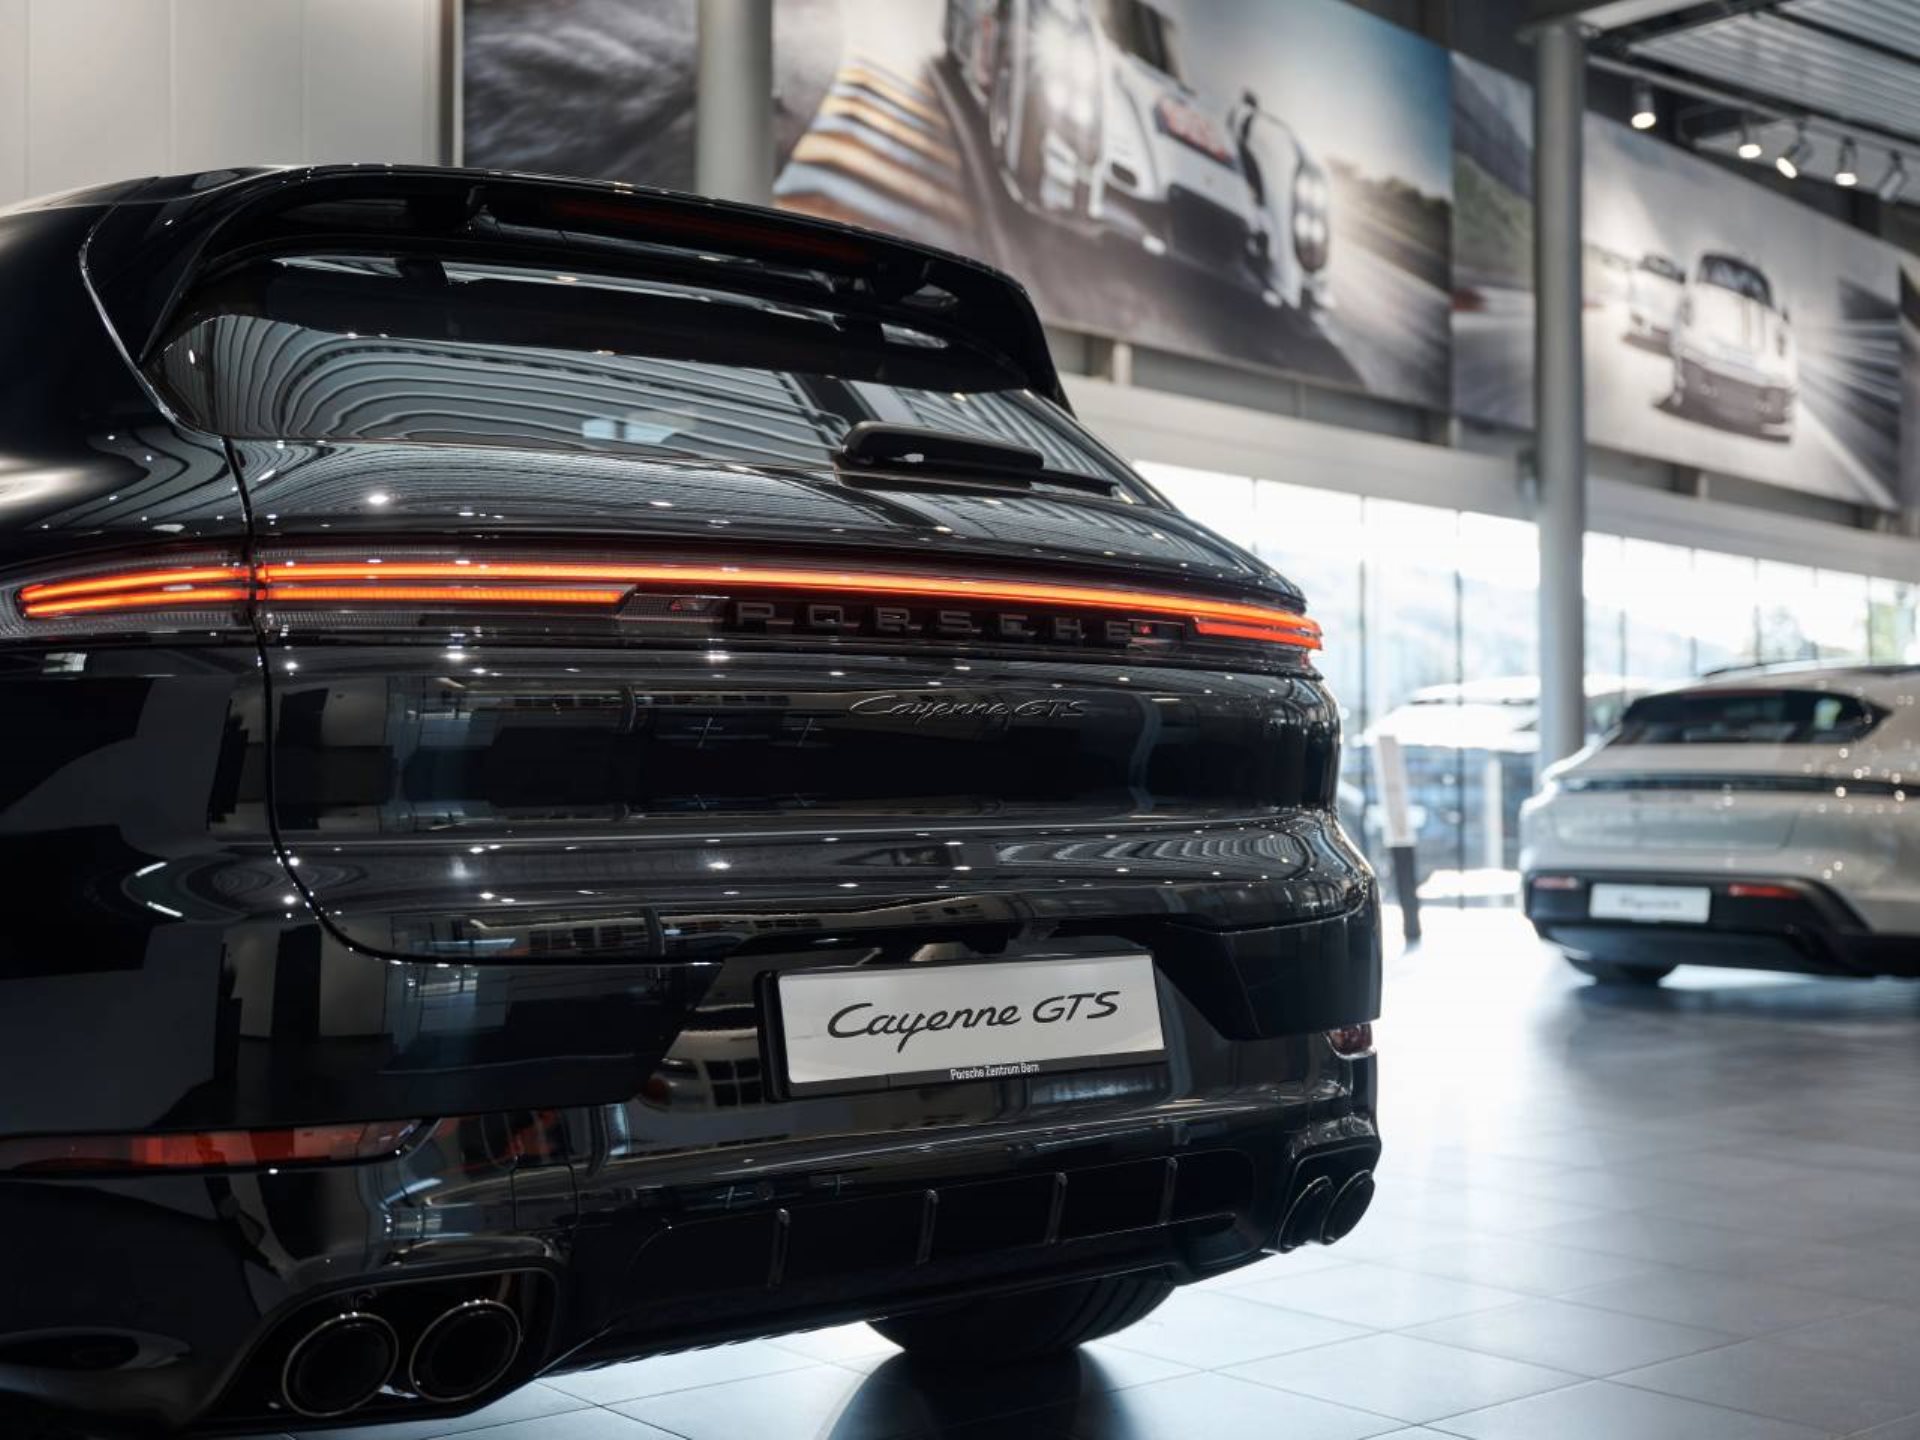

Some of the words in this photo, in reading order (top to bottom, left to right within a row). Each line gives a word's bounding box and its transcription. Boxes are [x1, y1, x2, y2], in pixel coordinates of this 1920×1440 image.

[737, 602, 1132, 641] PORSCHE
[850, 695, 1009, 725] Cayenne
[1014, 699, 1085, 717] GTS
[827, 1002, 1021, 1053] Cayenne
[1032, 990, 1121, 1023] GTS
[950, 1067, 985, 1080] Porsche
[984, 1064, 1020, 1078] Zentrum
[1020, 1062, 1040, 1074] Bern
